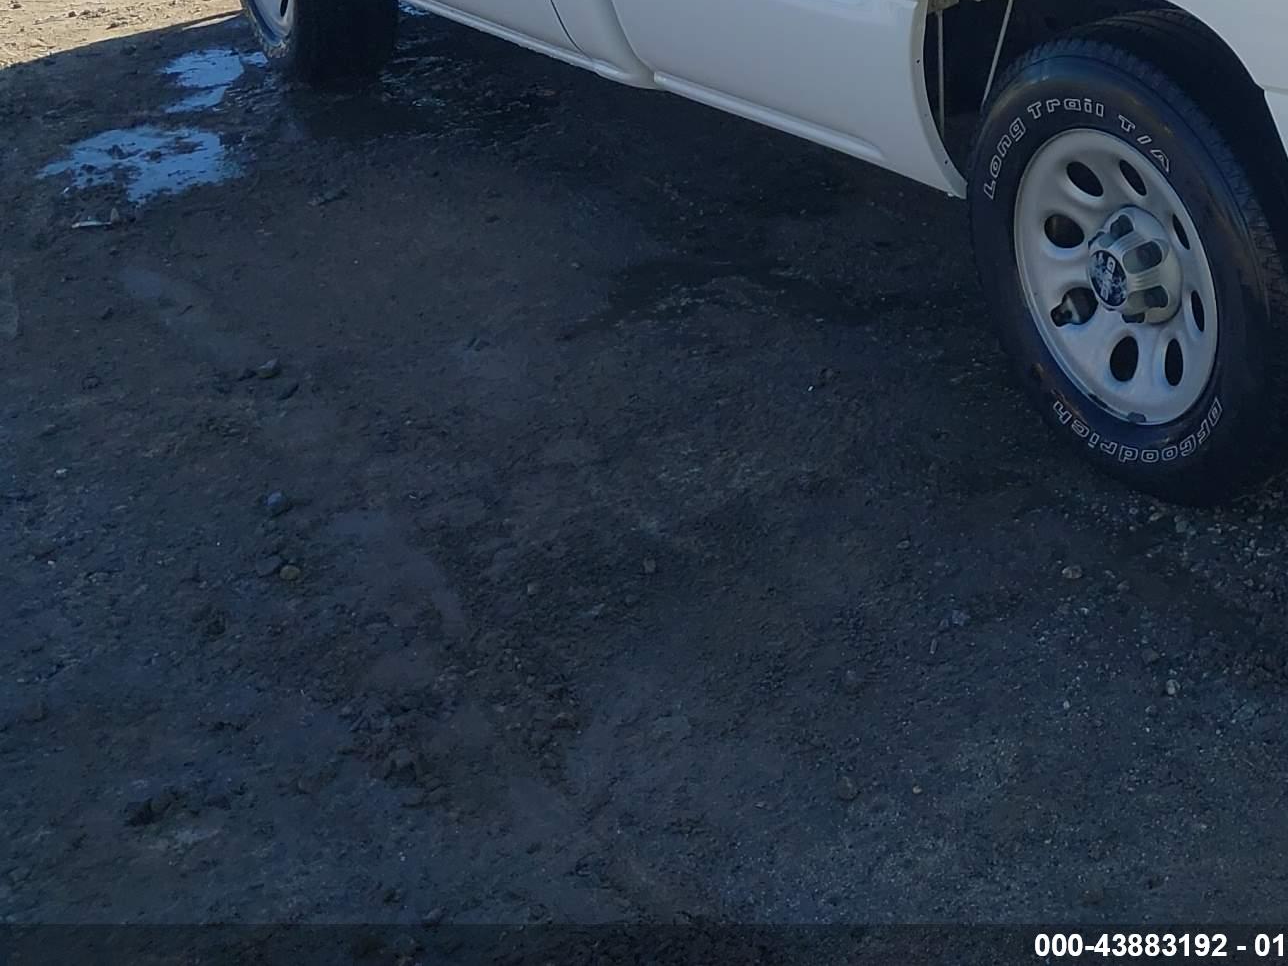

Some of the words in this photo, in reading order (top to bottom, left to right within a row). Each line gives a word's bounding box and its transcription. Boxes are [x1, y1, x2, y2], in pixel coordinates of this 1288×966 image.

[983, 117, 1027, 200] Long
[1027, 98, 1105, 120] Trail
[1118, 114, 1170, 173] T/A
